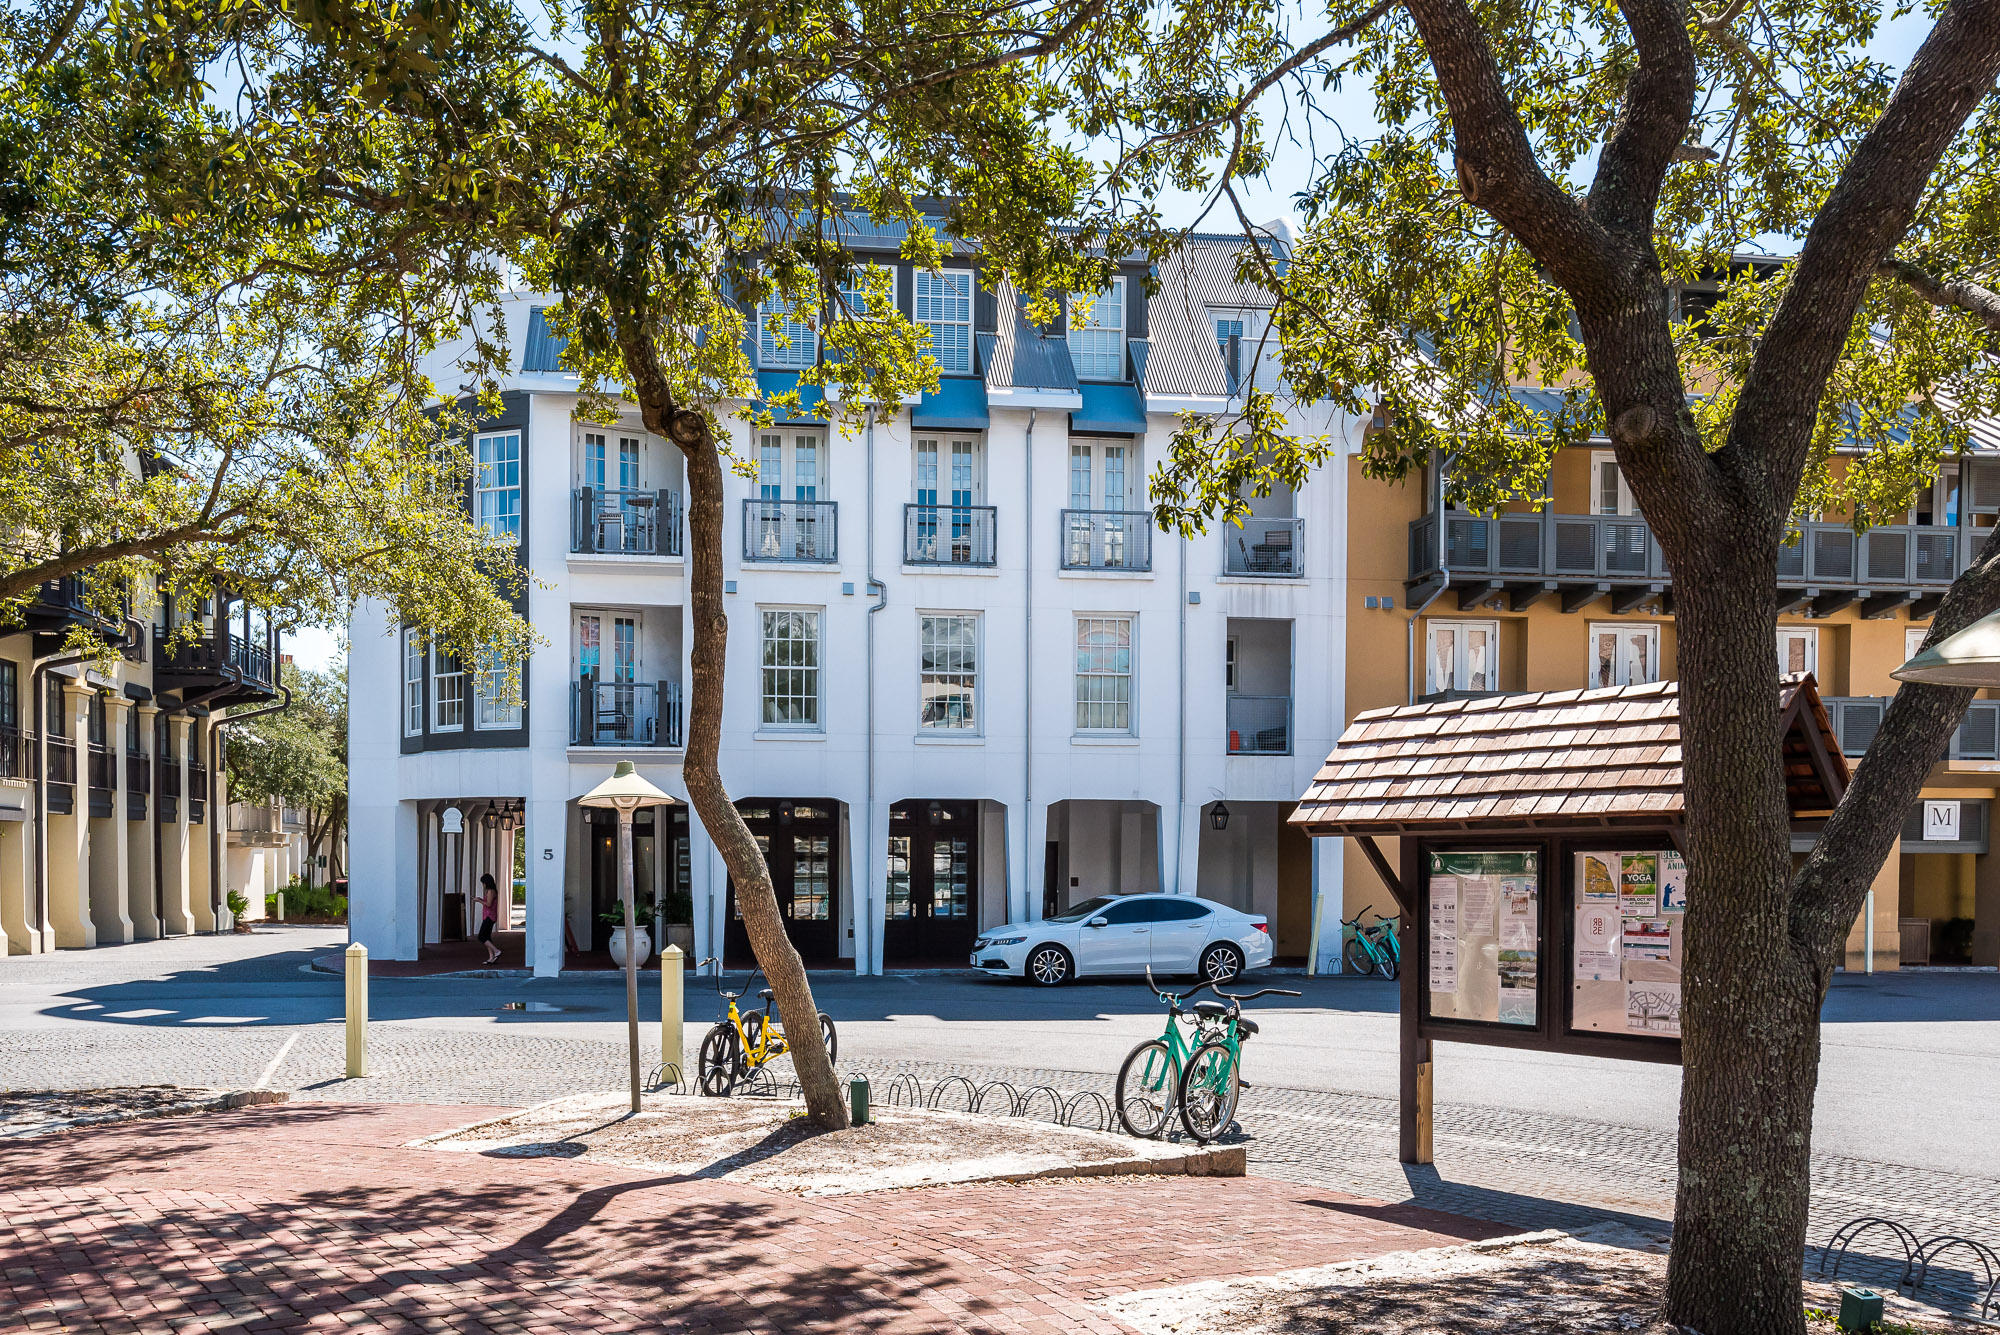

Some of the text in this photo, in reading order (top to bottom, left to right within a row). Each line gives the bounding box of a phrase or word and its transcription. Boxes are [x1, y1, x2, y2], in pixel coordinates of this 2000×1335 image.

[1932, 808, 1952, 825] M
[543, 848, 554, 860] 5
[1627, 874, 1652, 882] YOGA
